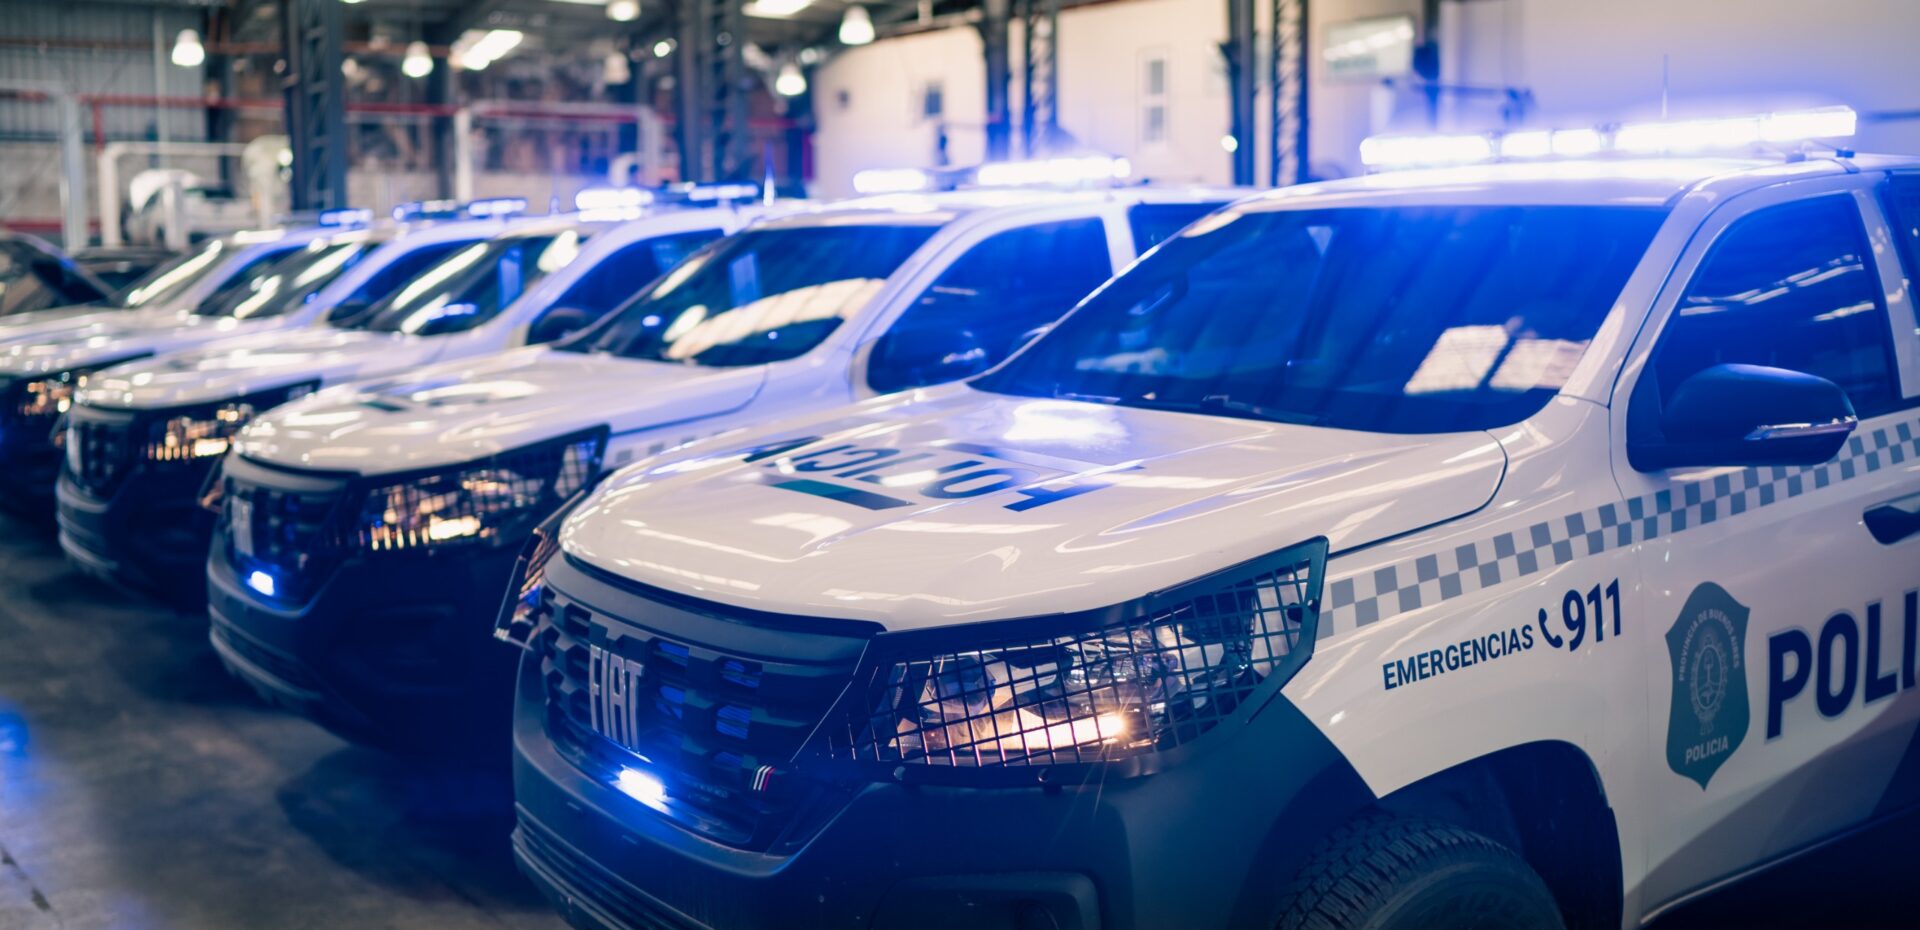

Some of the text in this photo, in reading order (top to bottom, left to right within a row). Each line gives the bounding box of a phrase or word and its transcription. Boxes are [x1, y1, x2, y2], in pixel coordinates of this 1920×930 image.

[1383, 577, 1621, 690] EMERGENCIAS 911
[1679, 608, 1739, 681] PROVINCIA DE BUENOS AIRES
[1765, 587, 1920, 743] POLI
[589, 643, 644, 753] FIAT
[1685, 735, 1729, 765] POLICIA
